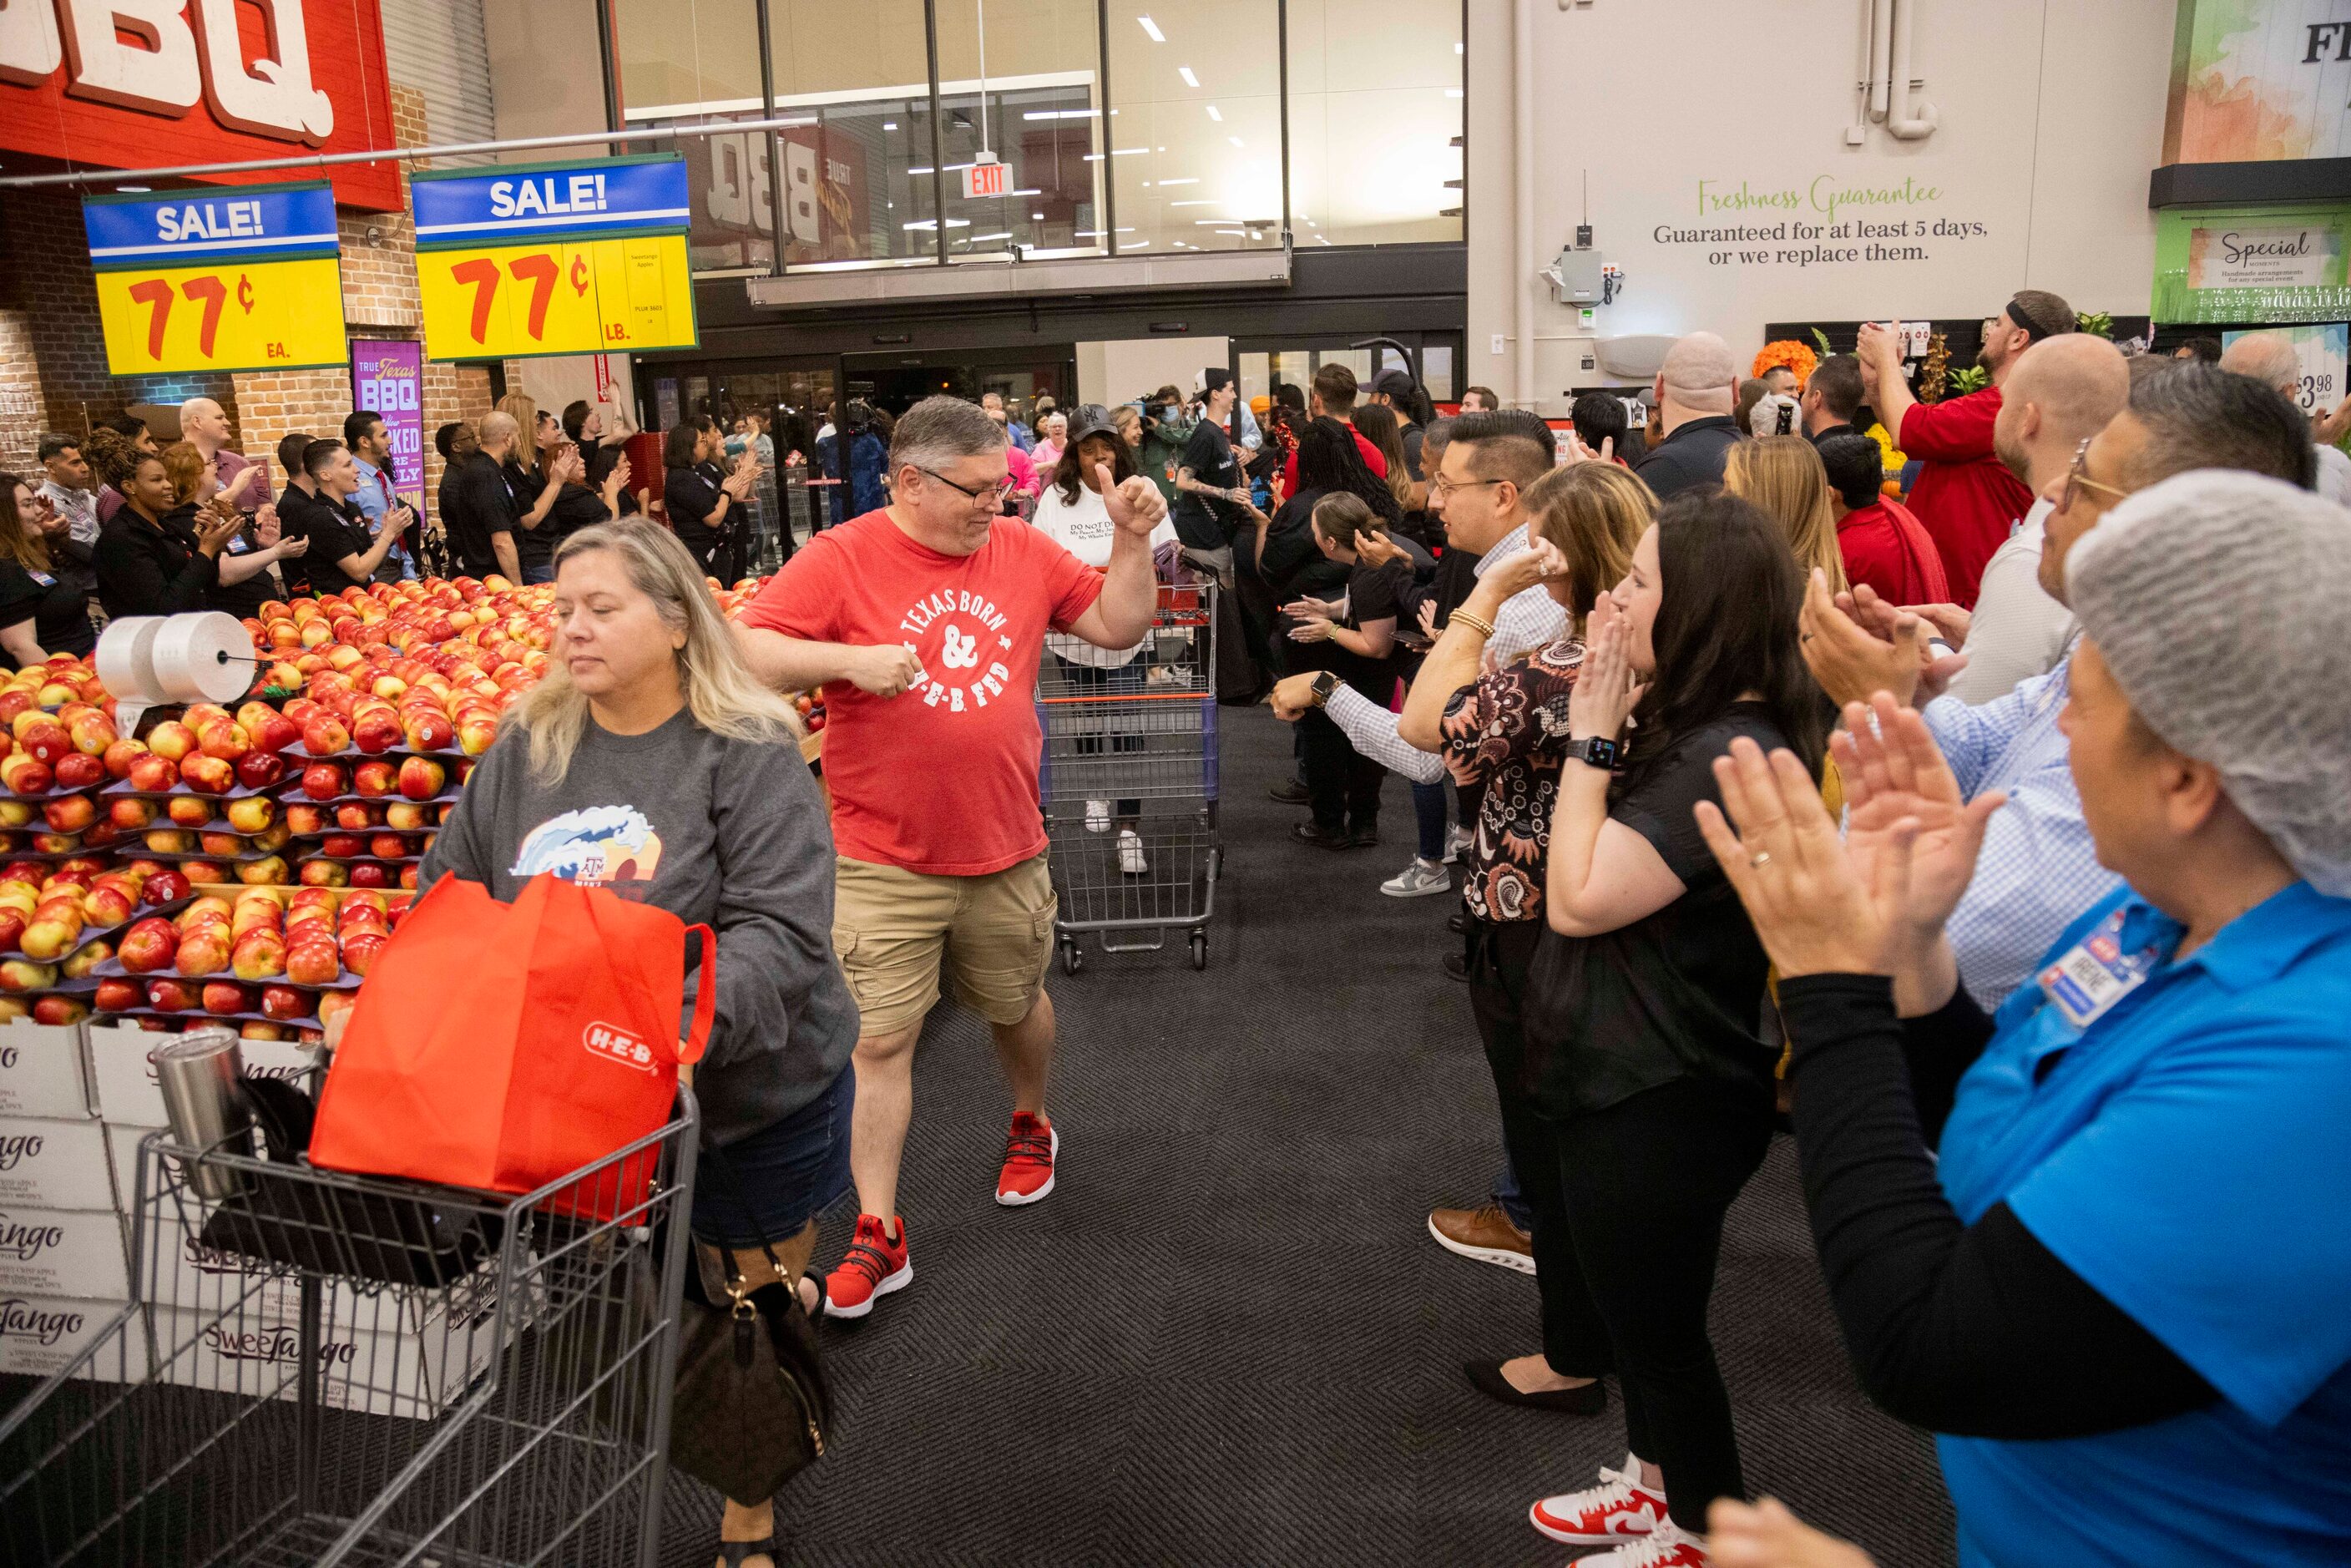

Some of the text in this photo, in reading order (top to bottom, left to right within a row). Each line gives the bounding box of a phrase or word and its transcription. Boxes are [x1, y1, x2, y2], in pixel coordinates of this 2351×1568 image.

[490, 174, 607, 217] SALE!
[972, 166, 1004, 195] EXIT
[1699, 175, 1944, 224] Freshness Guarantee
[156, 200, 264, 241] SALE!
[1653, 218, 1989, 244] Guaranteed for at least 5 days,
[1708, 243, 1929, 267] or we replace them.
[2222, 231, 2310, 268] Special
[605, 323, 630, 341] LB.
[266, 342, 291, 359] EA.
[359, 357, 417, 382] TRUE Texas
[361, 379, 419, 412] BBQ
[387, 427, 420, 454] KED
[1085, 522, 1103, 530] NOT
[900, 589, 1008, 635] TEXAS BORN
[942, 625, 978, 669] &
[970, 662, 1009, 707] FED
[590, 1028, 651, 1063] H-E-B
[205, 1323, 358, 1374] SweeTago
